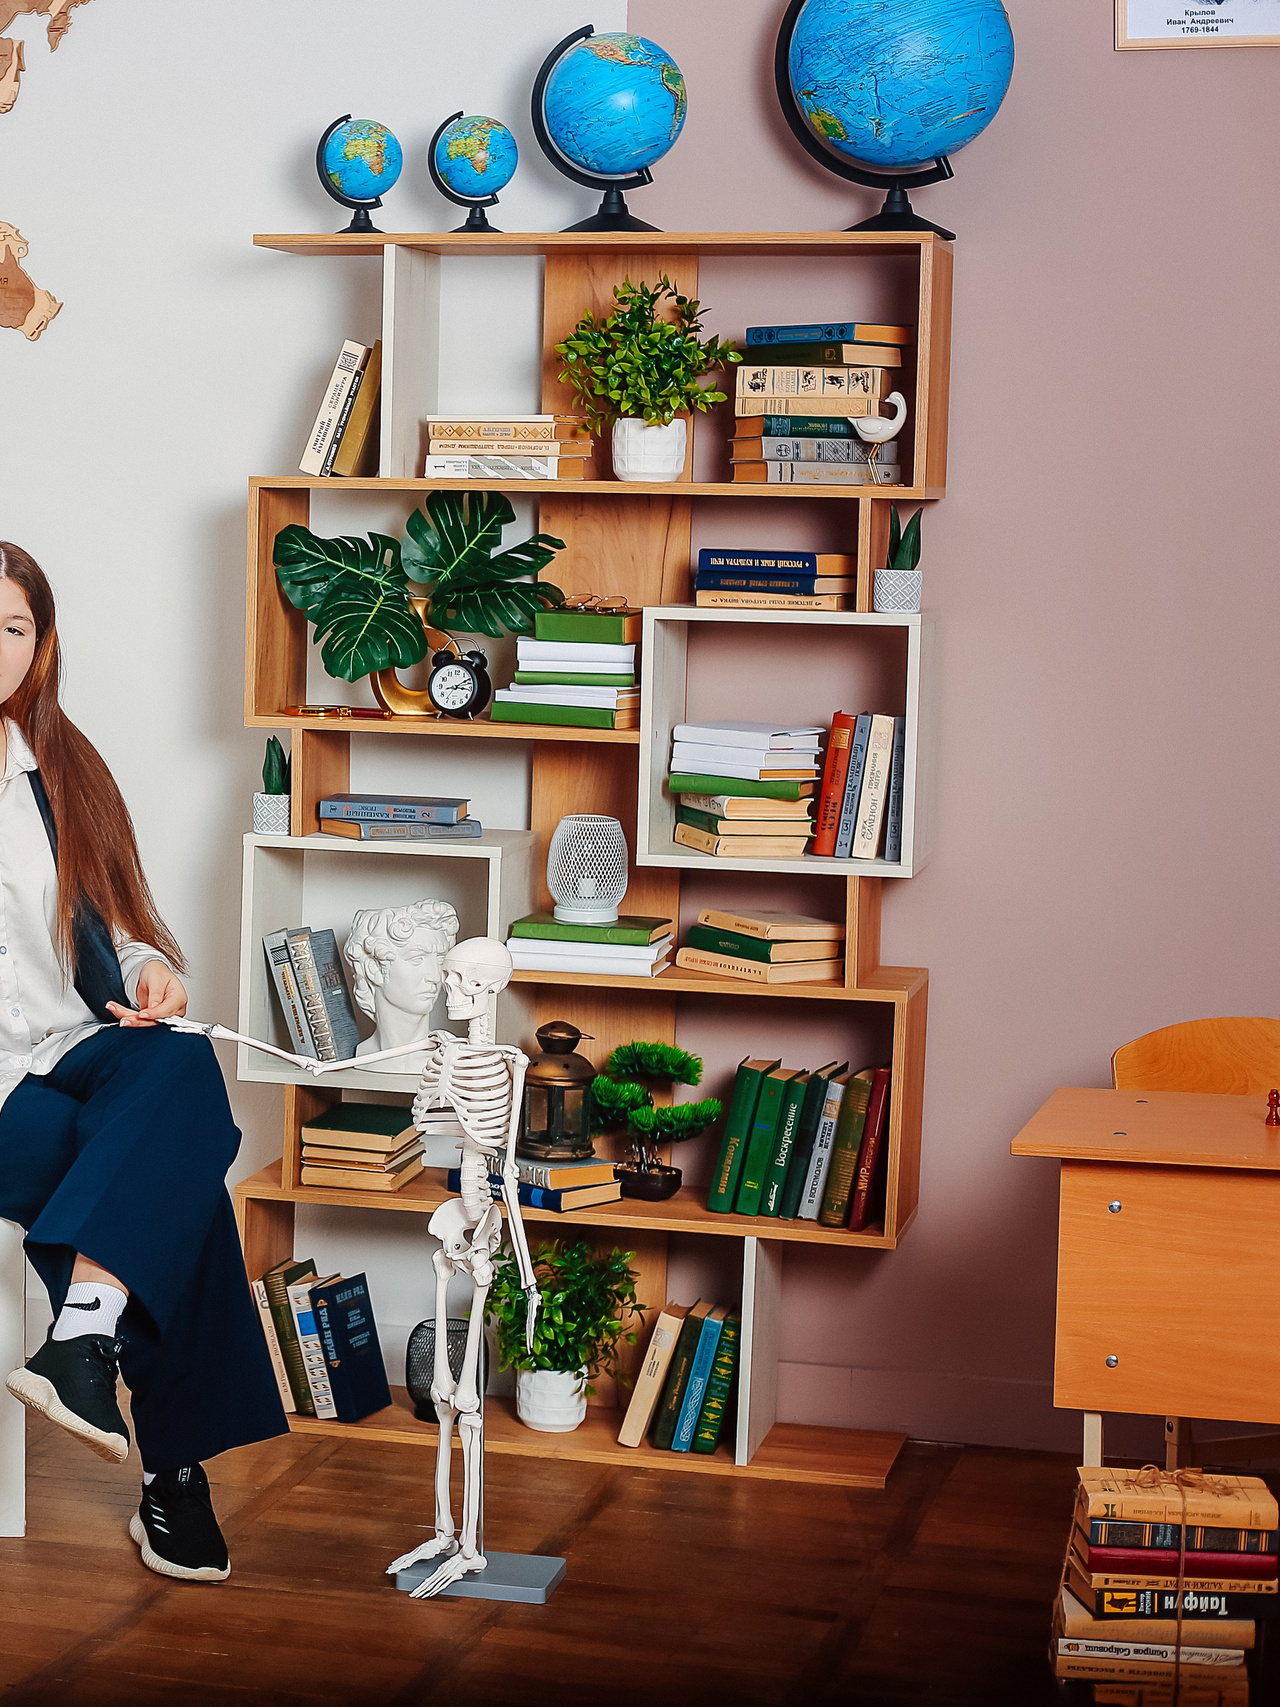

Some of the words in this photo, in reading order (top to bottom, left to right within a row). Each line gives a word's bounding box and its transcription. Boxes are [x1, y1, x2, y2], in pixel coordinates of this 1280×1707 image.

[1184, 9, 1216, 17] Крылов
[710, 557, 725, 565] РЕЧИ
[725, 558, 753, 567] КУЛЬТУРА
[754, 558, 759, 567] И
[760, 559, 776, 567] ЯЗЫК
[777, 559, 803, 569] РУССКИЙ
[868, 752, 878, 789] ПРИЗНАНИЯ
[346, 810, 390, 819] КАМЕННЫЙ
[421, 810, 432, 818] 2
[865, 798, 878, 841] СИМЕНОН
[843, 822, 849, 832] 3
[774, 1102, 798, 1167] Воскресение
[718, 1137, 740, 1194] Конармия
[858, 1167, 872, 1191] МИР
[866, 1137, 876, 1169] ИСТОРИИ
[809, 1157, 823, 1199] БОГОМОЛОВ
[318, 1307, 330, 1329] РИД
[323, 1329, 338, 1360] МАЙН
[1164, 1578, 1224, 1591] ХАДЖИ-МРАТ
[1084, 1643, 1130, 1657] Сокровищ
[1133, 1645, 1168, 1658] Остров
[1066, 1664, 1116, 1674] РАССКАЗЫ
